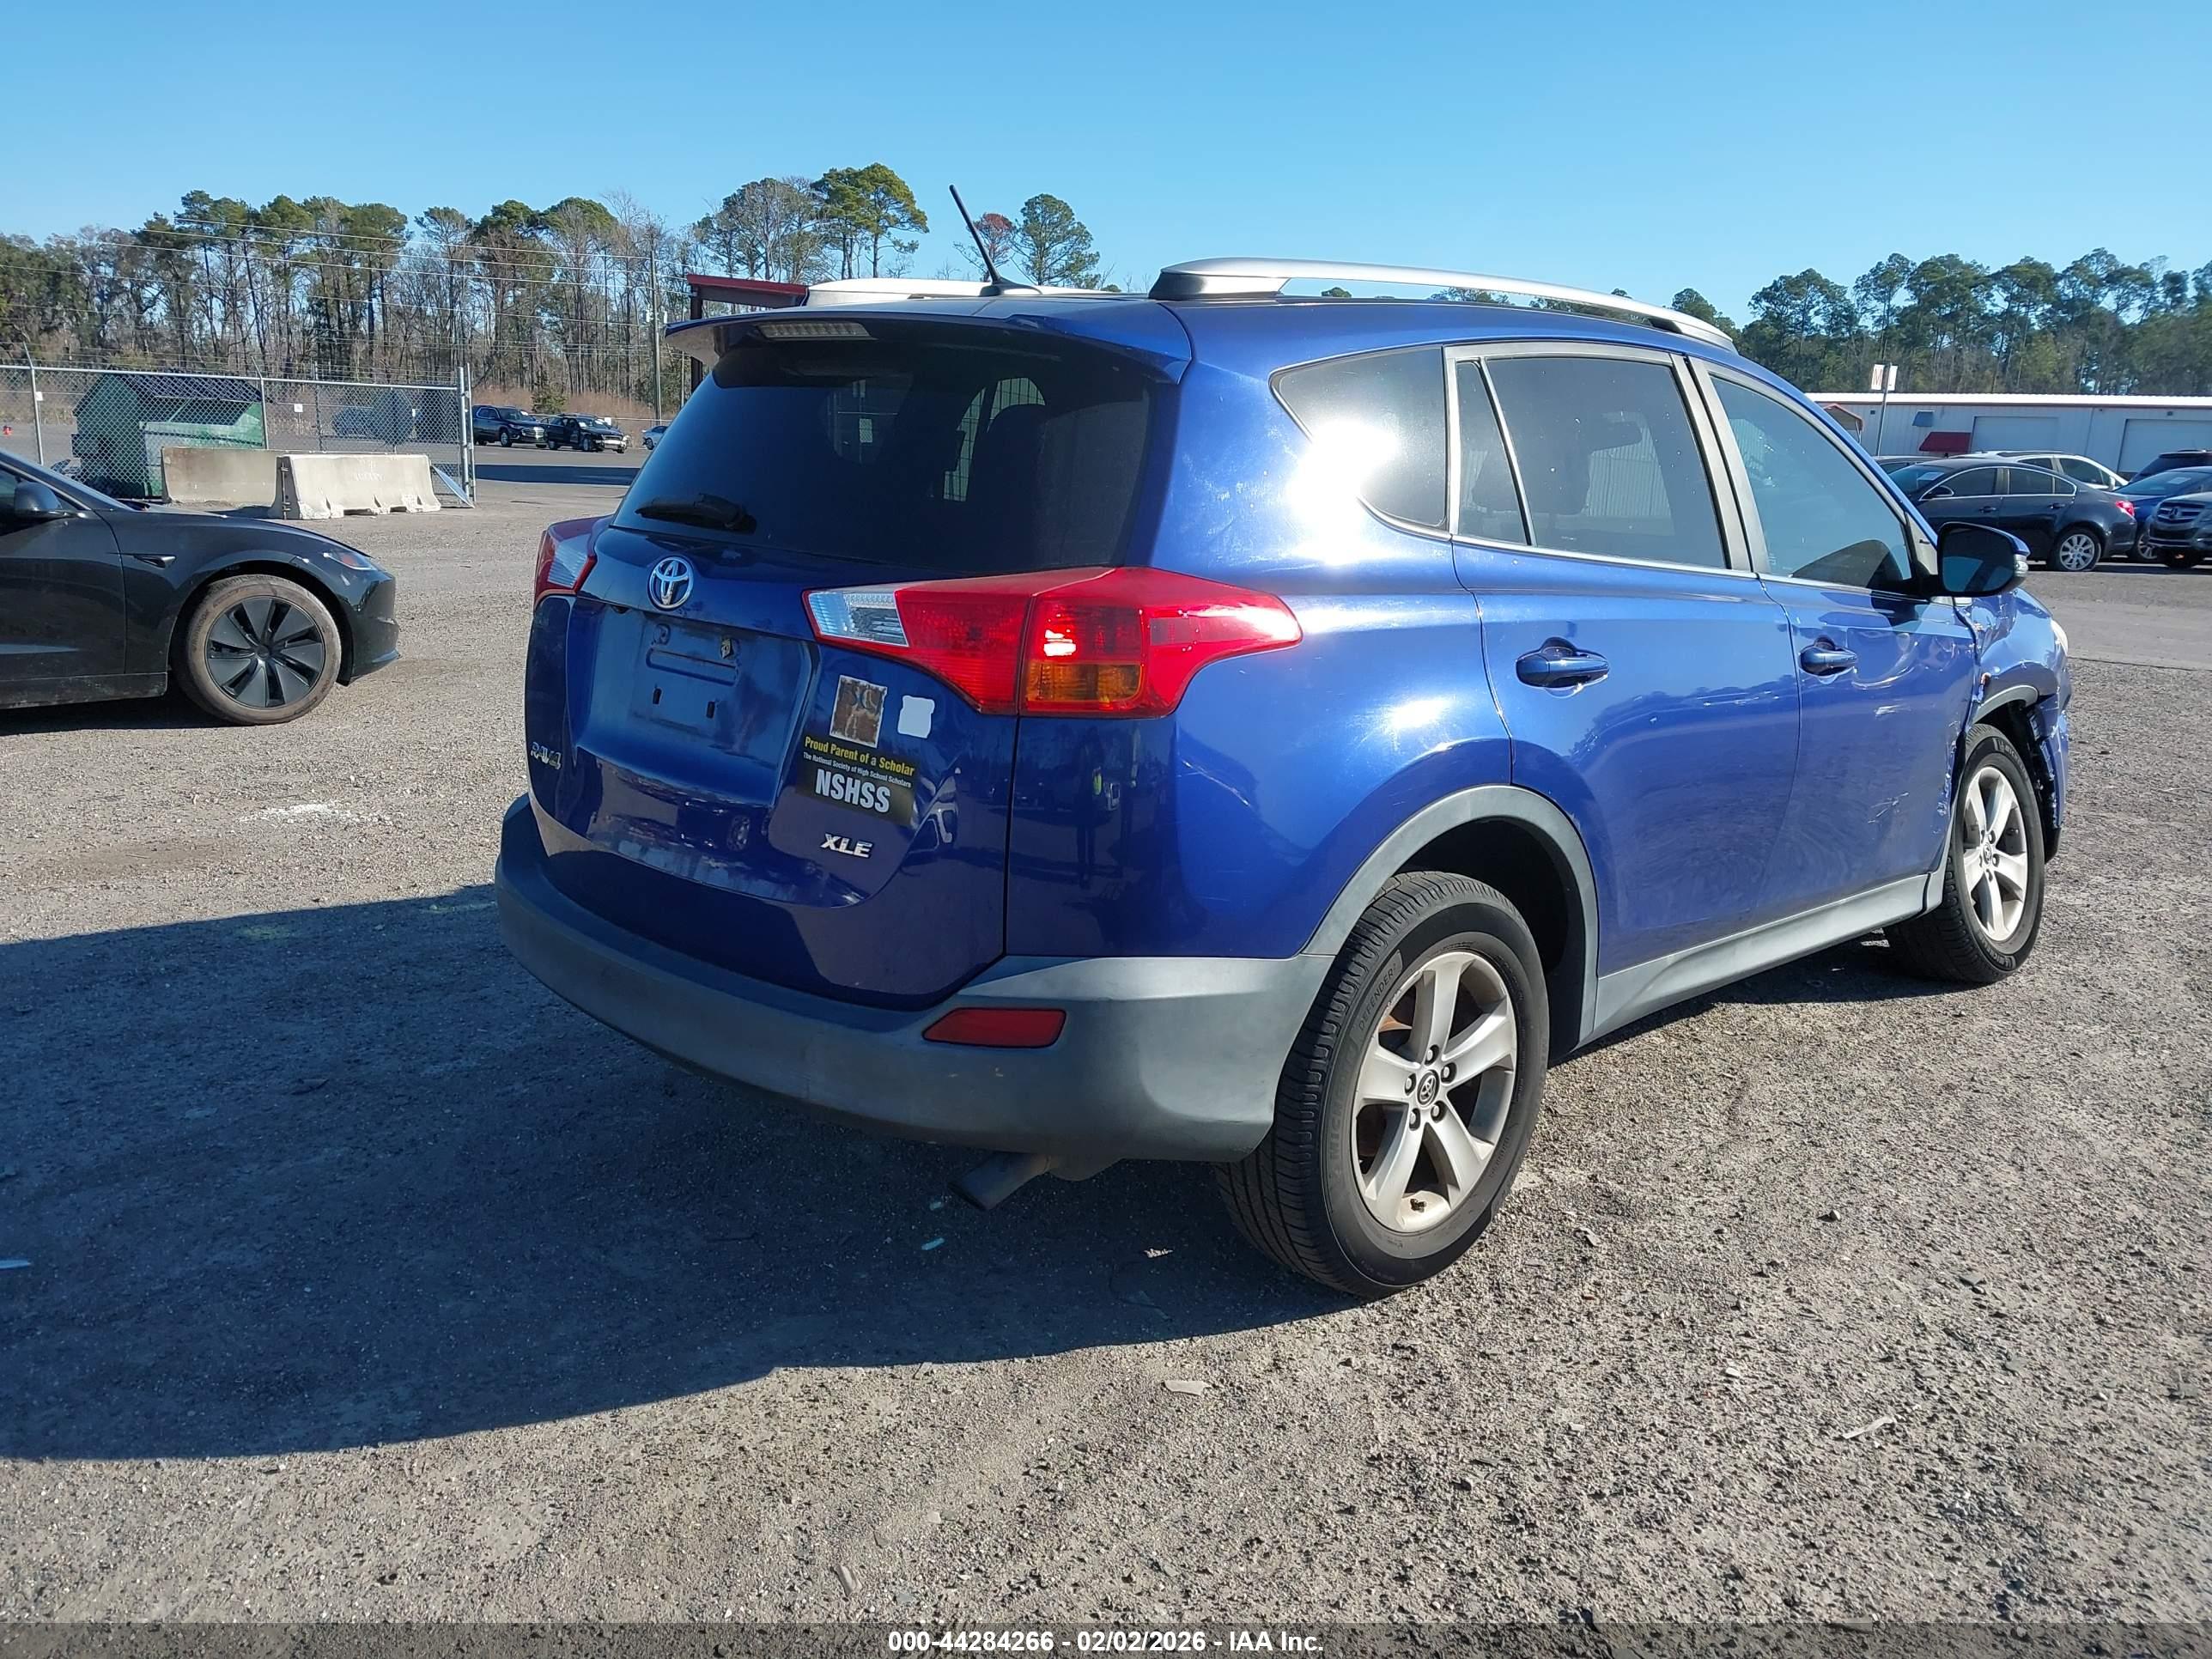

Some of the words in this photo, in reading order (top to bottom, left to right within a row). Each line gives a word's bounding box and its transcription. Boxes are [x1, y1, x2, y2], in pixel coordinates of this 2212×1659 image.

[805, 736, 829, 753] Proud
[830, 742, 859, 761] Parent
[860, 753, 870, 764] of
[871, 757, 877, 766] a
[878, 757, 915, 776] Scholar
[815, 769, 891, 813] NSHSS
[819, 833, 873, 859] XLE
